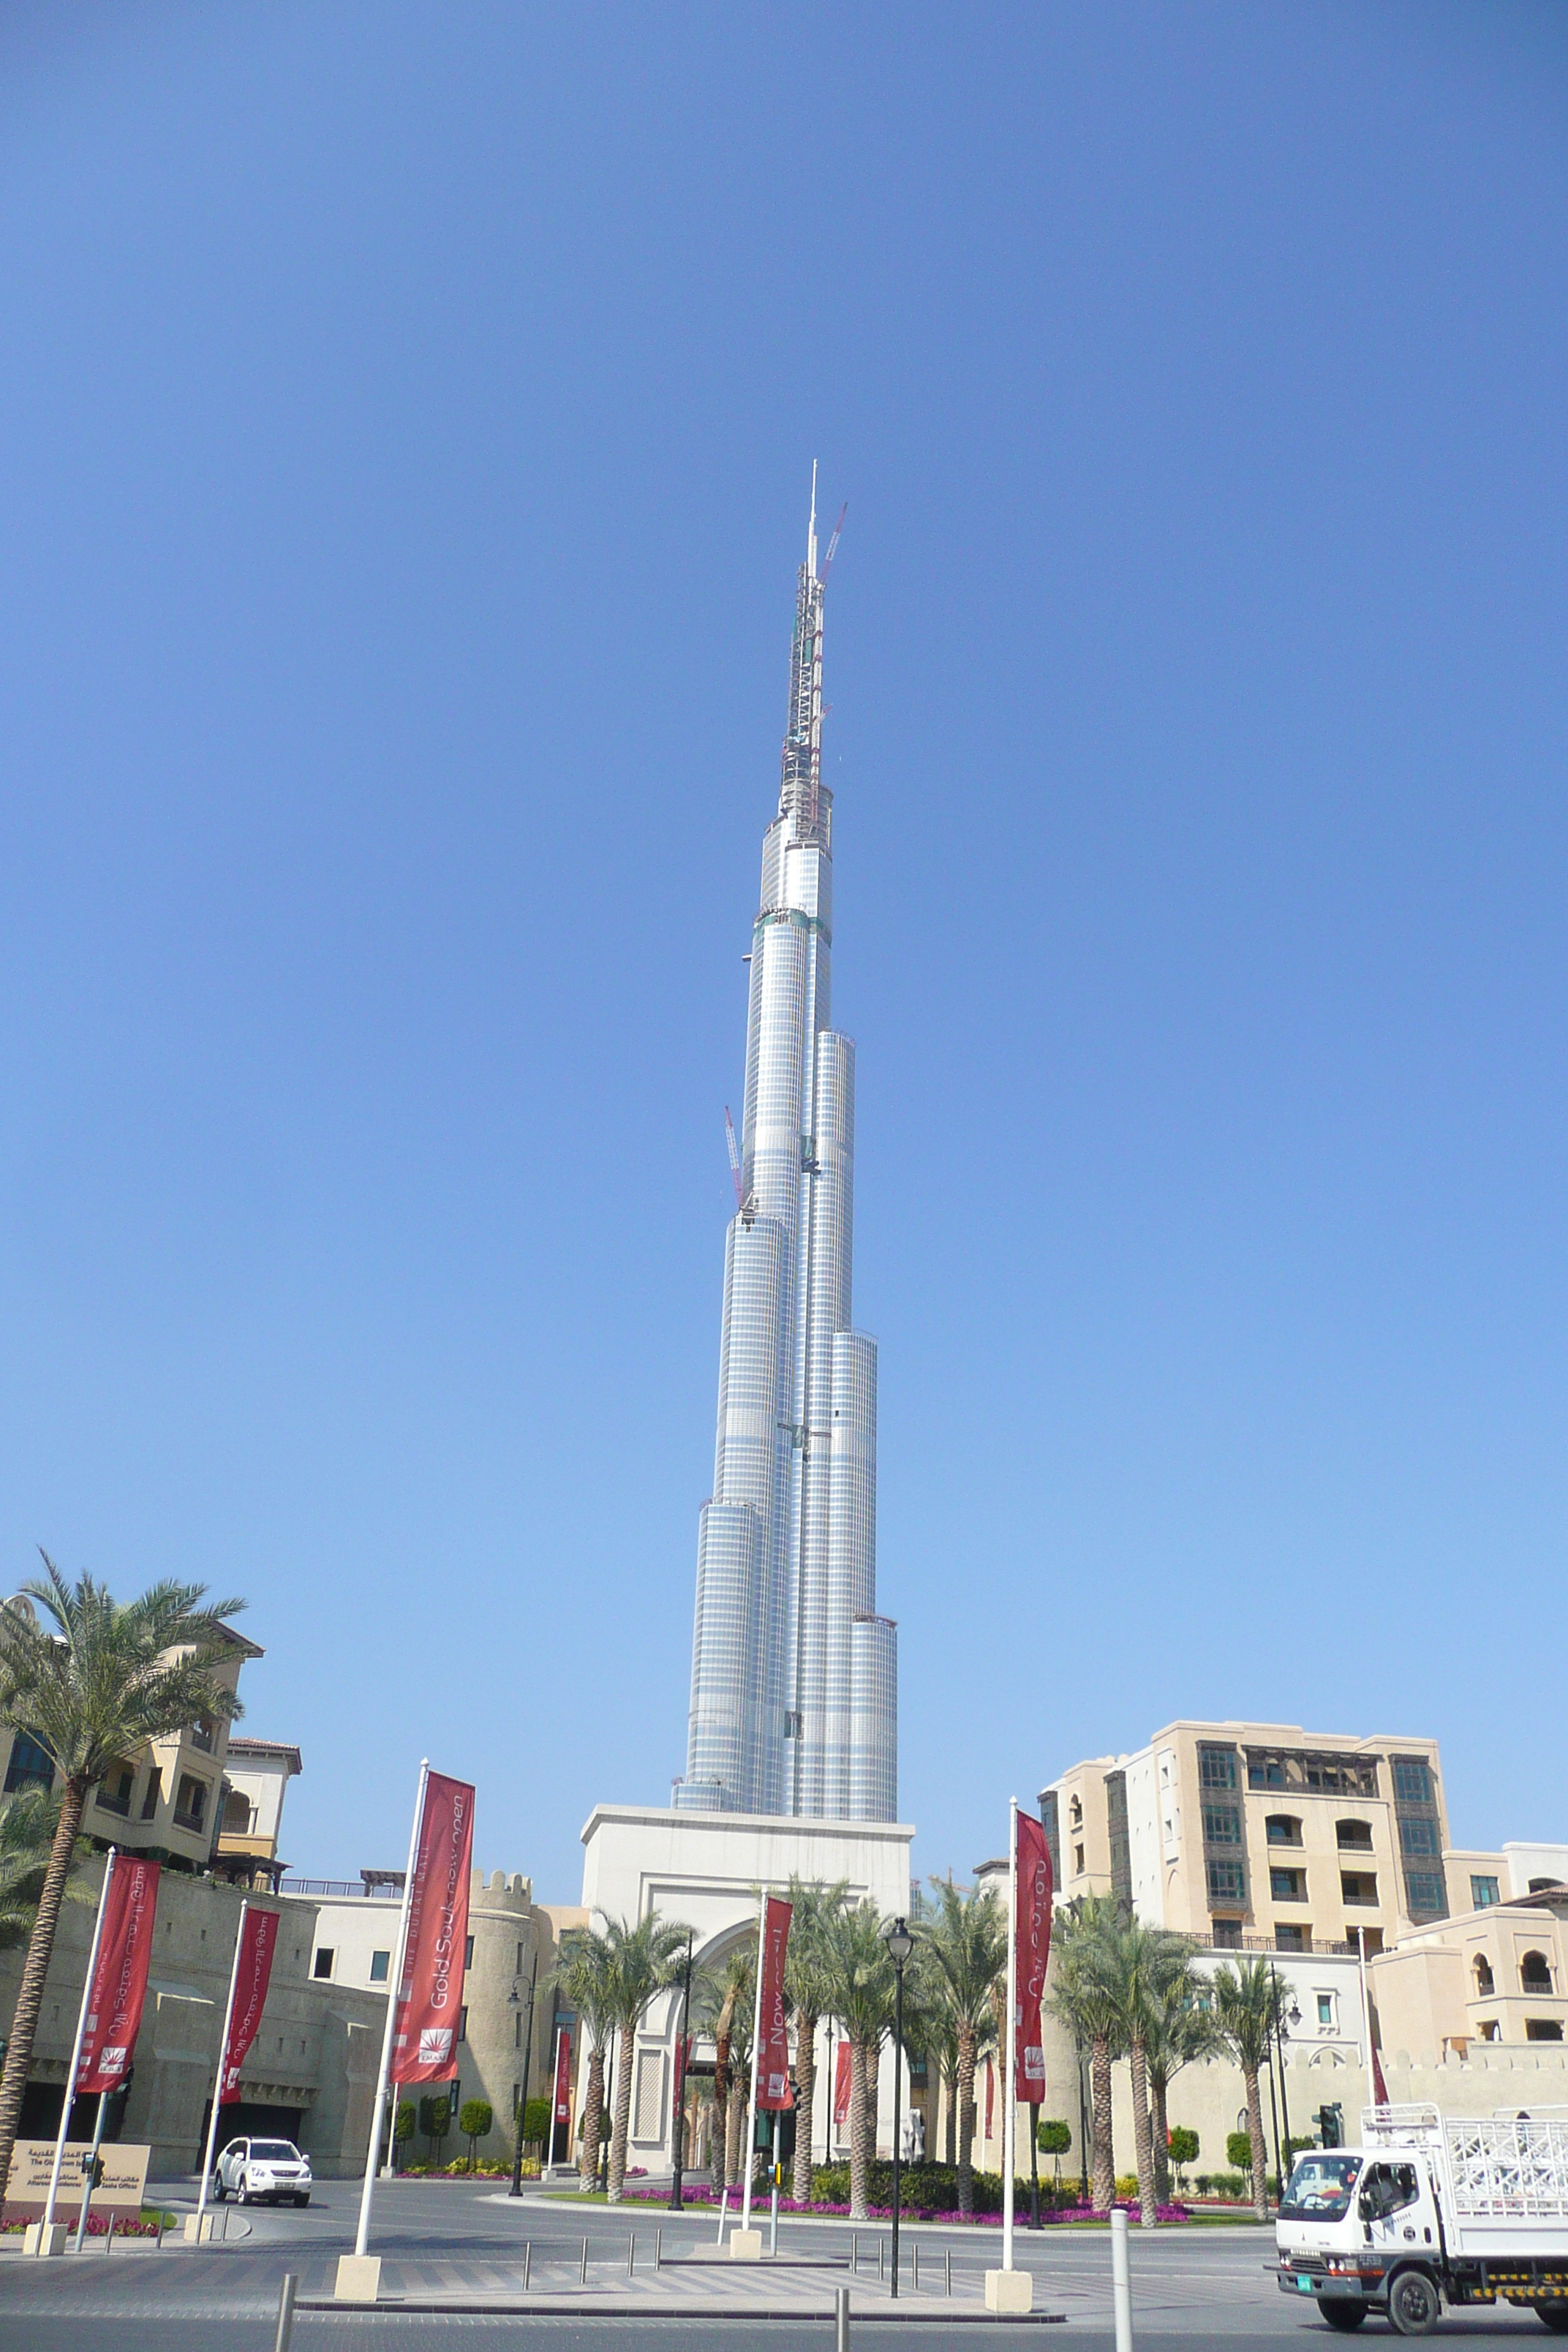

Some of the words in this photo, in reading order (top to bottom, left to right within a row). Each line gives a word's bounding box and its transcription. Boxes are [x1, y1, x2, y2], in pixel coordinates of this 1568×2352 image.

[437, 1904, 454, 1953] Souk
[404, 1949, 413, 1973] THE
[431, 1960, 450, 2010] Gold
[770, 1994, 783, 2045] Now
